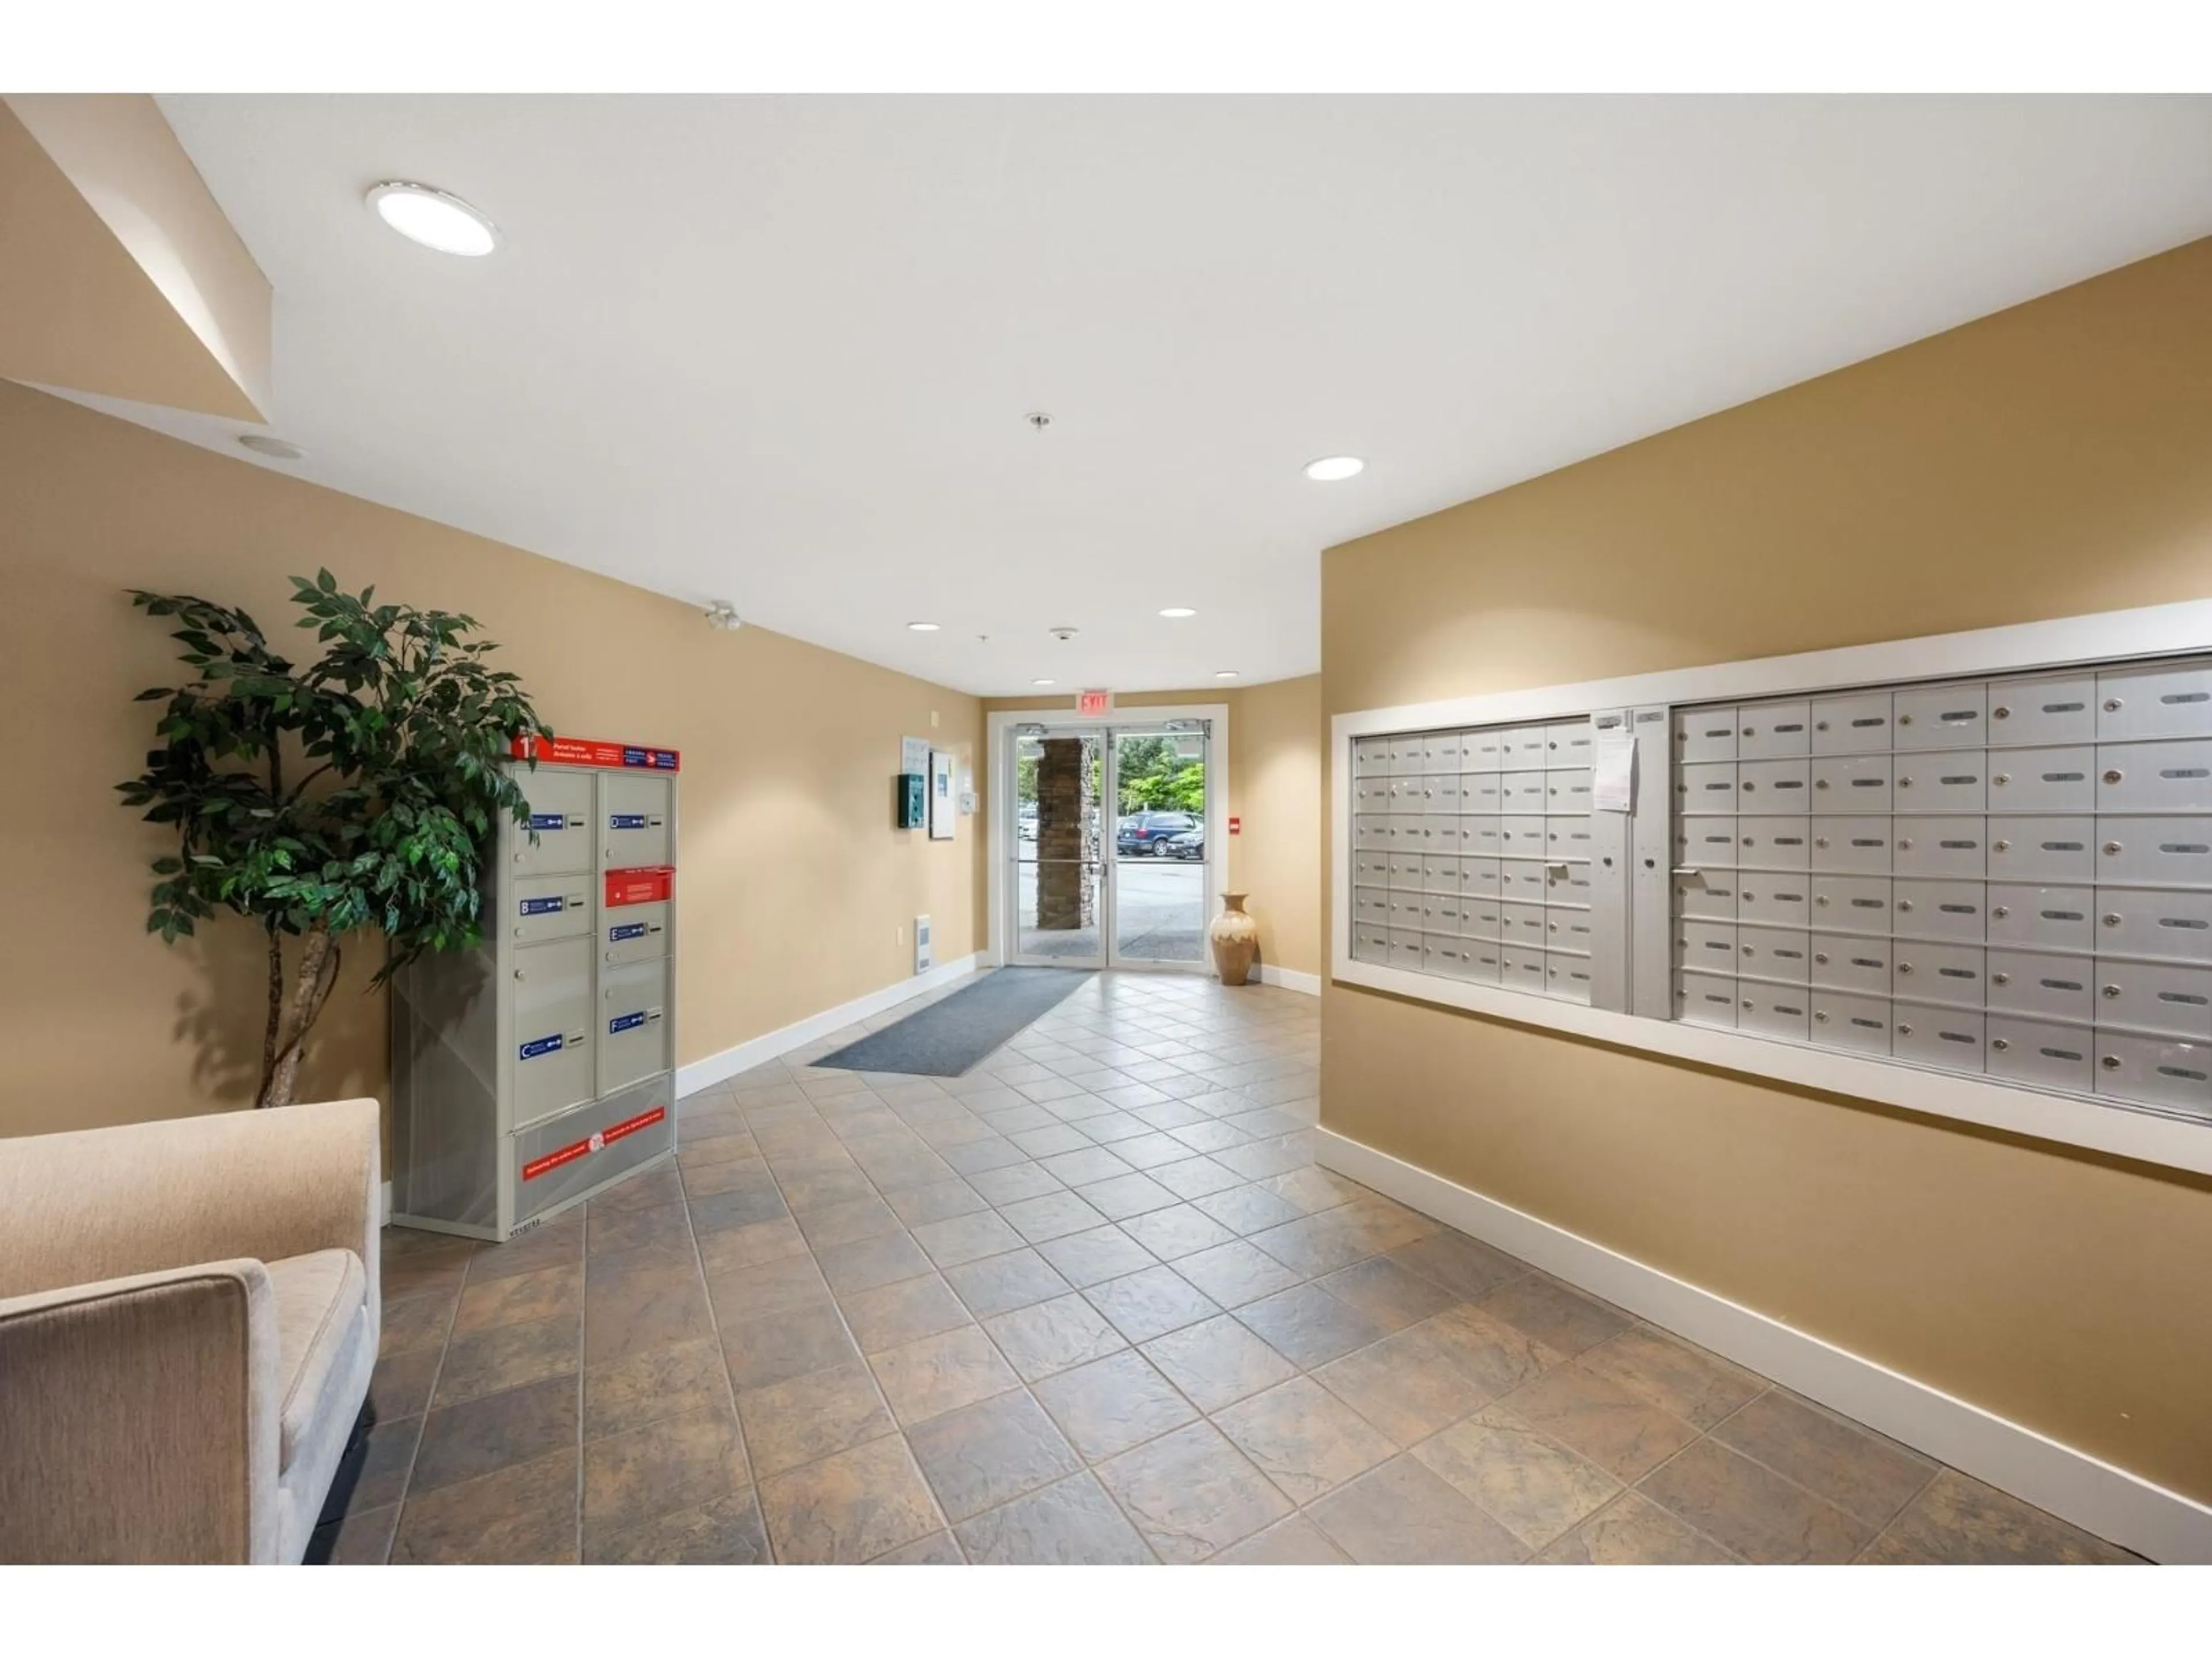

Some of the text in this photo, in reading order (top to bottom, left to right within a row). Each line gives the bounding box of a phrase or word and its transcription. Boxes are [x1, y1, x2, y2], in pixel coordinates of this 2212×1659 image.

[611, 817, 619, 828] D
[521, 901, 529, 914] B
[612, 929, 618, 941] E
[612, 1021, 618, 1032] F
[521, 1045, 531, 1058] C
